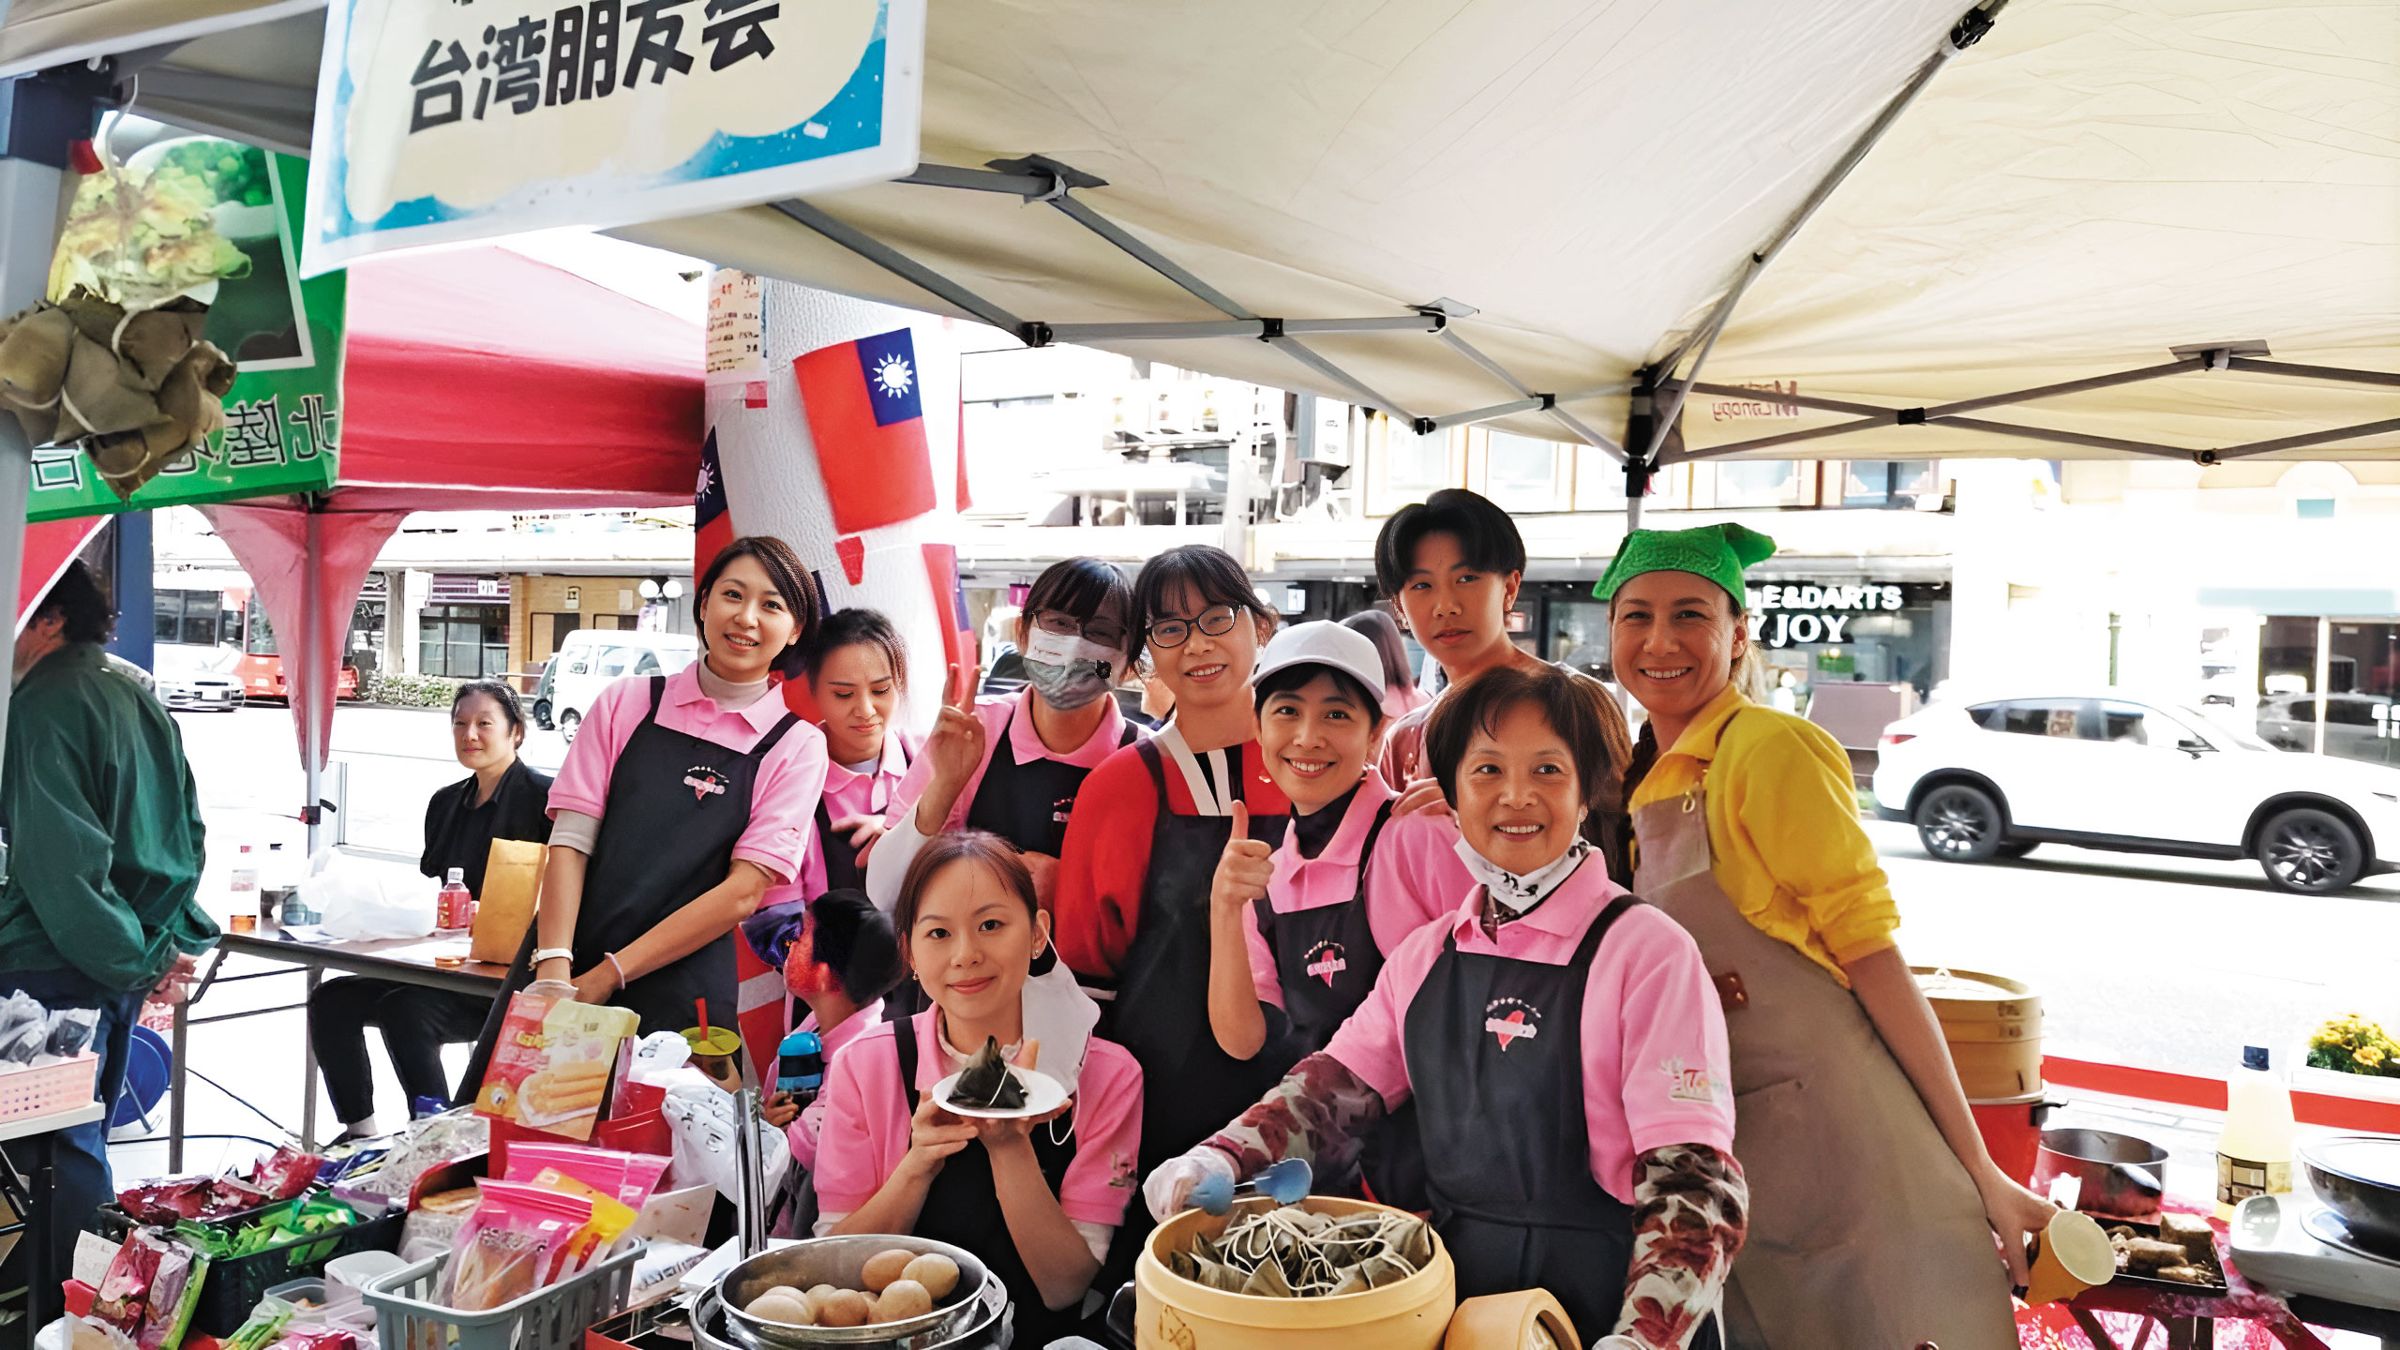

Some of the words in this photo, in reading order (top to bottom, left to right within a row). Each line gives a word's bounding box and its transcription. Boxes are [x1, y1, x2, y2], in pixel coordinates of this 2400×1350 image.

[410, 0, 780, 134] 台湾朋友会
[1769, 613, 1849, 648] JOY
